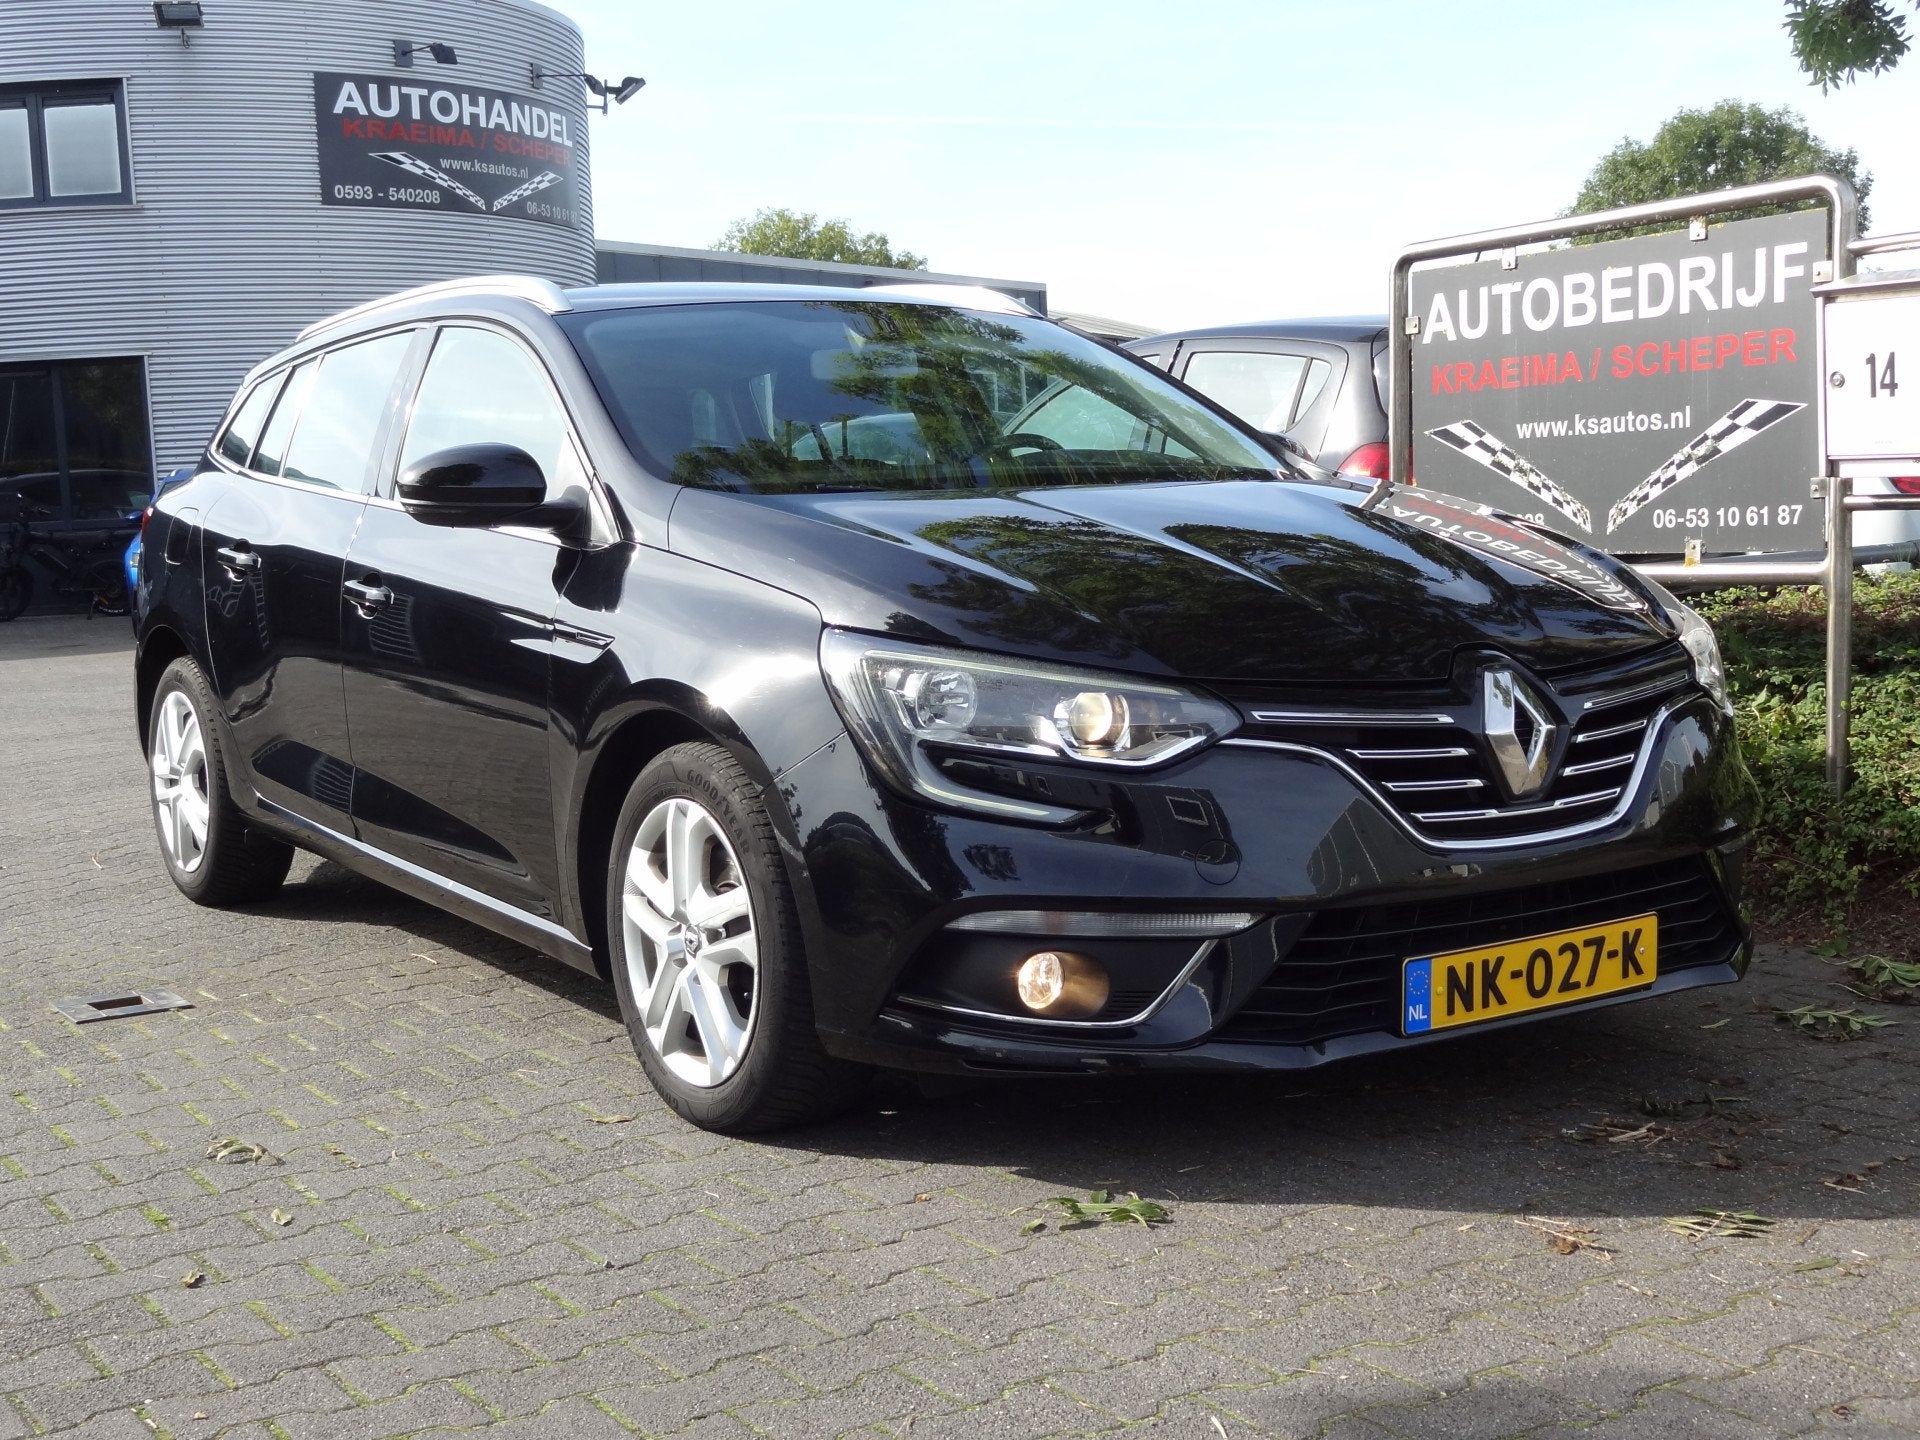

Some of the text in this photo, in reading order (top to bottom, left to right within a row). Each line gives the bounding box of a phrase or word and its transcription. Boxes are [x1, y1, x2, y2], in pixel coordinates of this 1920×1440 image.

[333, 82, 572, 147] AUTOHANDEL
[343, 118, 475, 148] KRAEIMA
[495, 133, 571, 167] SCHEPER
[440, 158, 528, 179] www.ksautos.nl
[334, 184, 373, 200] 0593
[389, 188, 441, 204] 540208
[527, 201, 551, 217] 06-53
[1421, 241, 1808, 345] AUTOBEDRIJF
[1431, 327, 1797, 395] KRAEIMA / SCHEPER
[1865, 351, 1899, 398] 14
[1516, 405, 1691, 440] www.ksautos.nl
[1652, 504, 1804, 529] 06-53 10 61 87
[1446, 927, 1645, 1017] NK-027-K
[1408, 1003, 1428, 1022] NL
